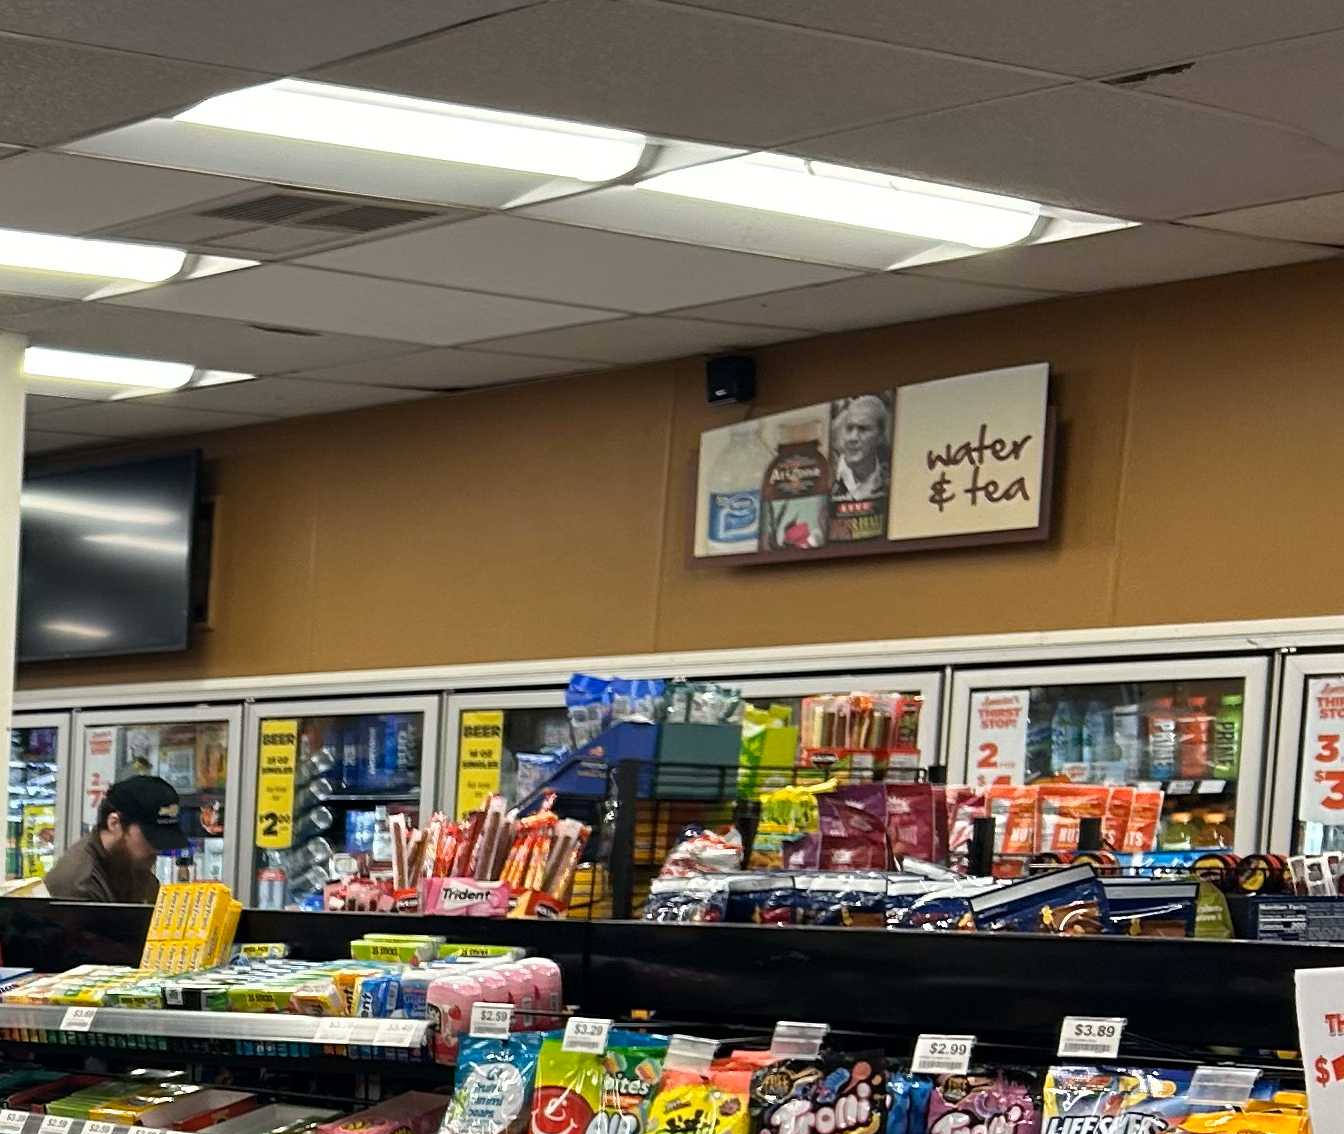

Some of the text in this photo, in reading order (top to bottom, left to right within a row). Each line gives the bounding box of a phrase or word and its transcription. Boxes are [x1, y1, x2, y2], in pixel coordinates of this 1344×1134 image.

[926, 424, 1034, 471] water
[928, 466, 1030, 512] & tea
[462, 723, 502, 738] BEER
[263, 733, 295, 745] BEER
[977, 743, 999, 769] 2
[1314, 734, 1340, 763] 3
[441, 887, 493, 903] Trident
[1074, 1024, 1115, 1038] $3.89
[930, 1042, 967, 1056] $2.99
